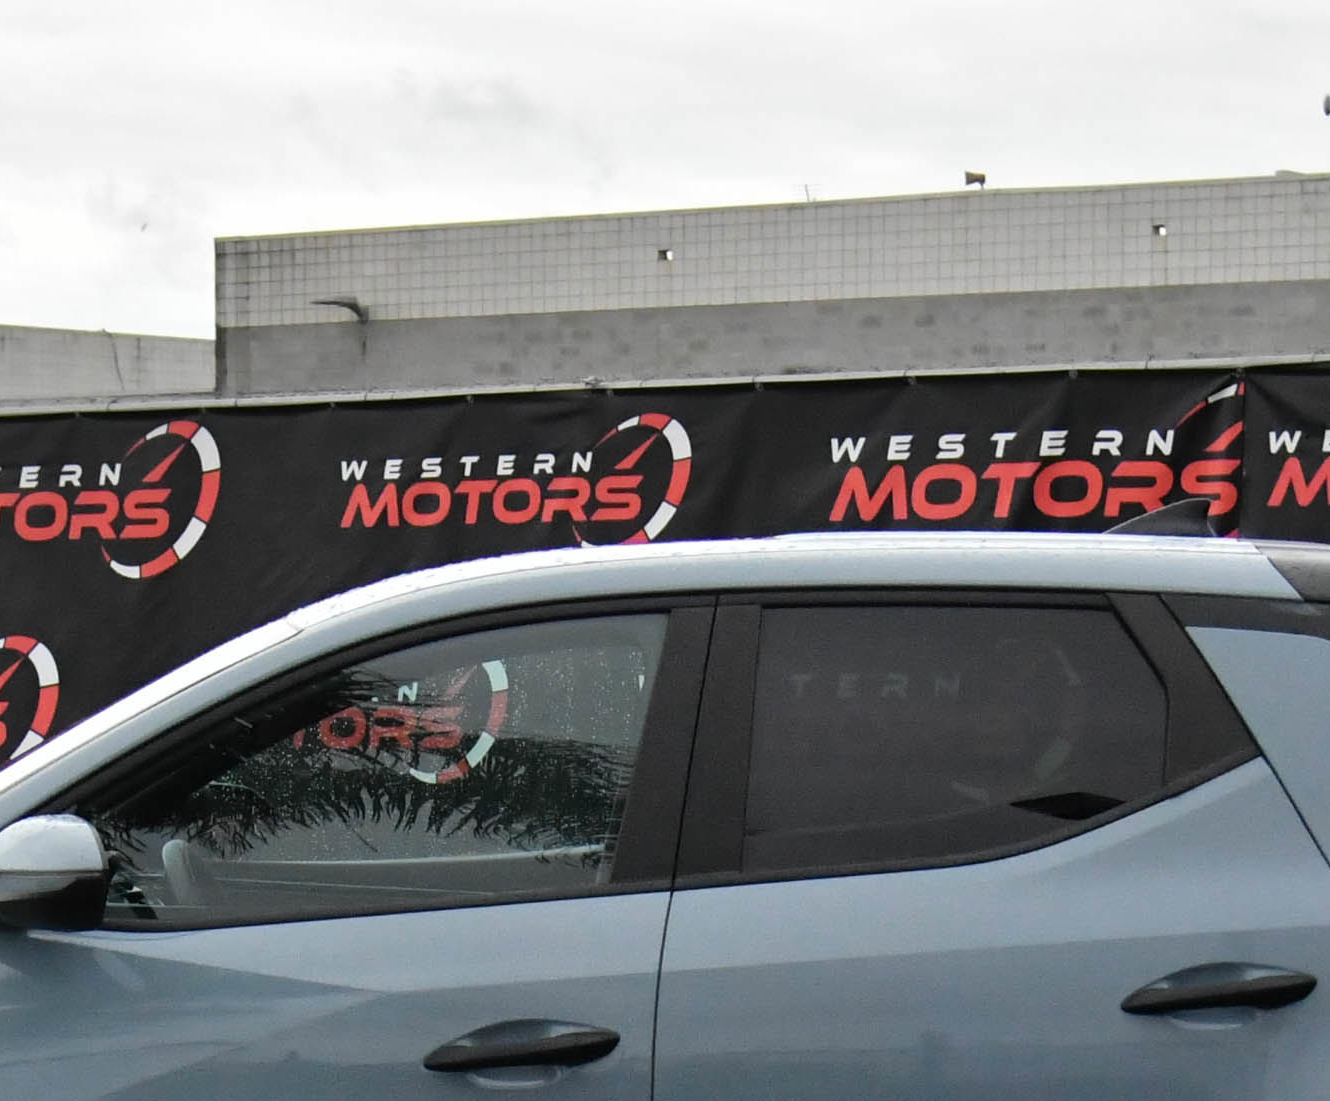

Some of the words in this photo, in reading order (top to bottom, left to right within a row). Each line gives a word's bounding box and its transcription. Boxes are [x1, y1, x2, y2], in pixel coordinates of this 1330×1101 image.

[340, 451, 593, 482] WESTERN
[830, 429, 1175, 464] WESTERN
[341, 474, 644, 529] MOTORS
[829, 458, 1241, 522] MOTORS
